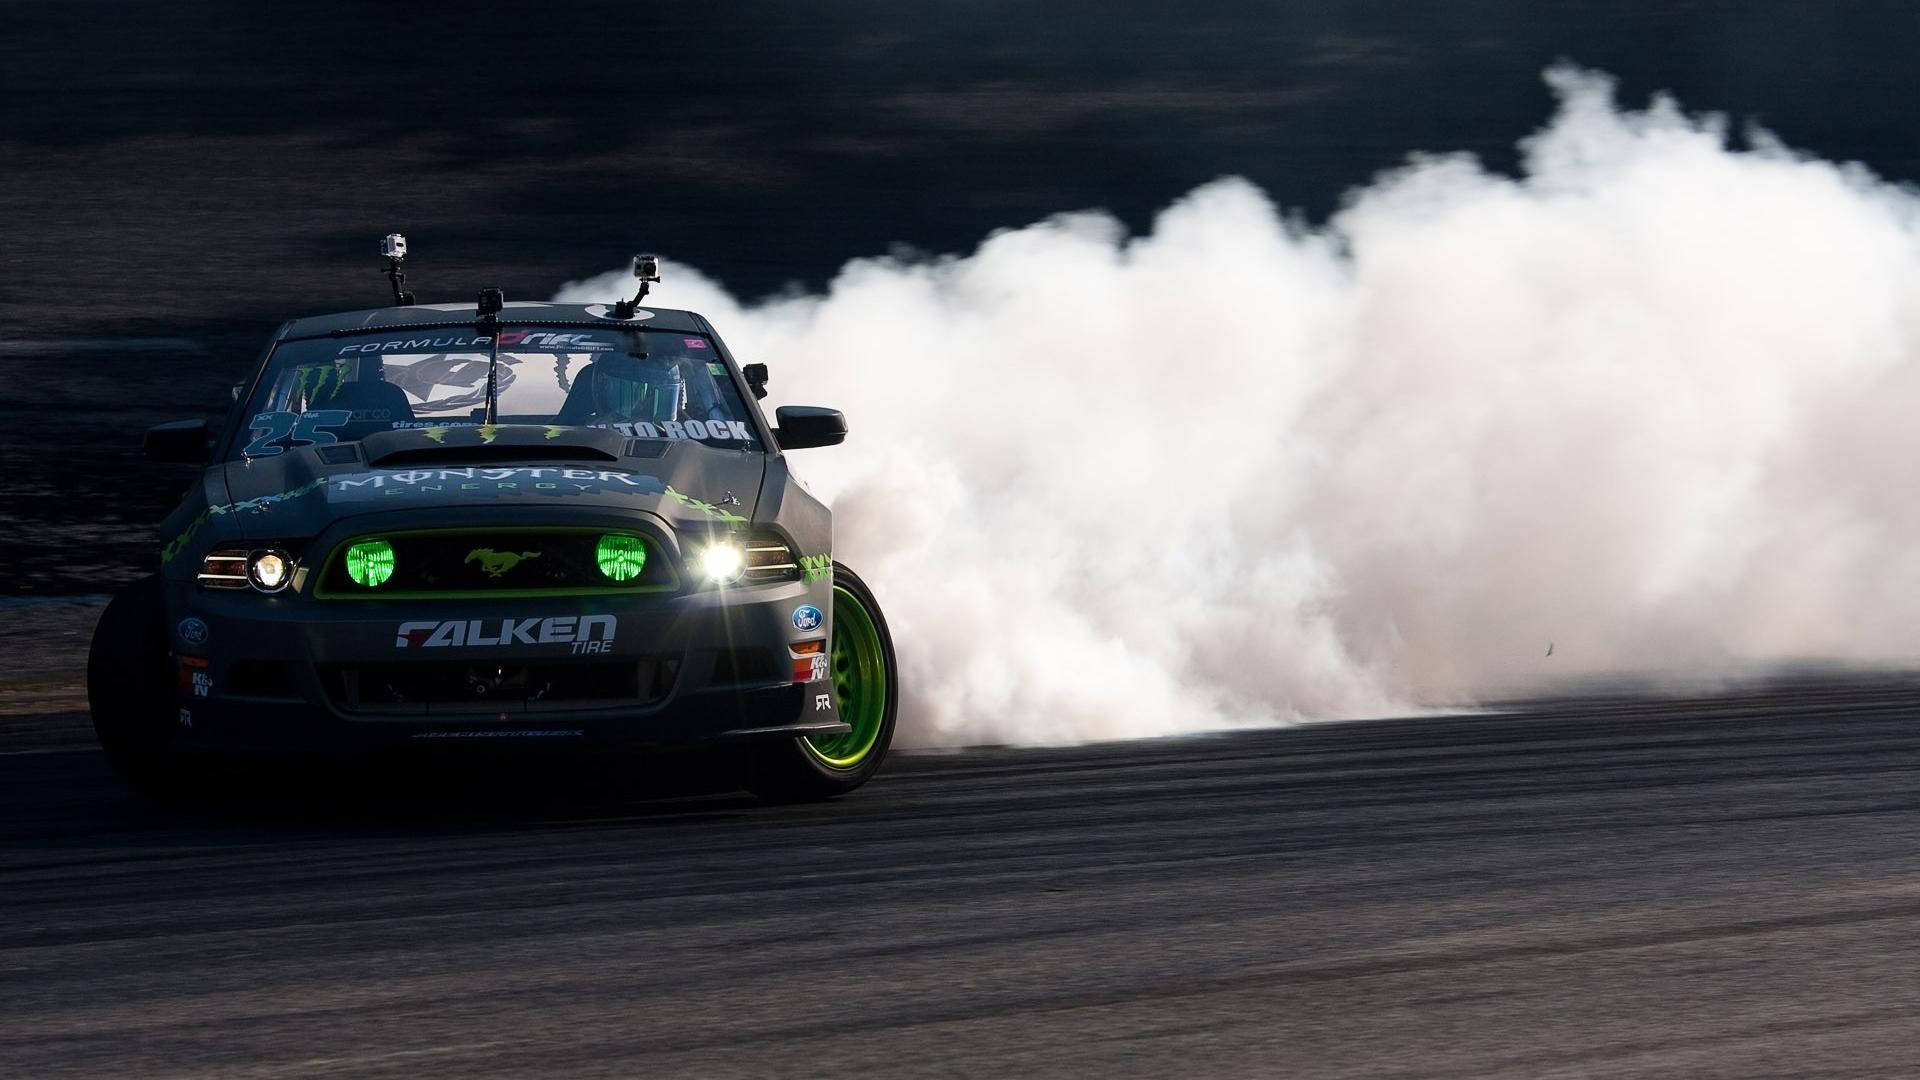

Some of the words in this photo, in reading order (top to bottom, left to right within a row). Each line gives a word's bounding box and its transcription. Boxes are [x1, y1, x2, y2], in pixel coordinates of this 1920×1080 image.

[338, 336, 493, 355] FORMULA
[352, 407, 391, 418] arco
[243, 410, 352, 456] 25
[612, 422, 659, 437] TO
[663, 420, 754, 440] ROCK
[338, 467, 639, 490] MONSTER
[385, 482, 592, 495] ENERGY
[396, 614, 617, 647] FALKEN
[571, 640, 613, 654] TIRE
